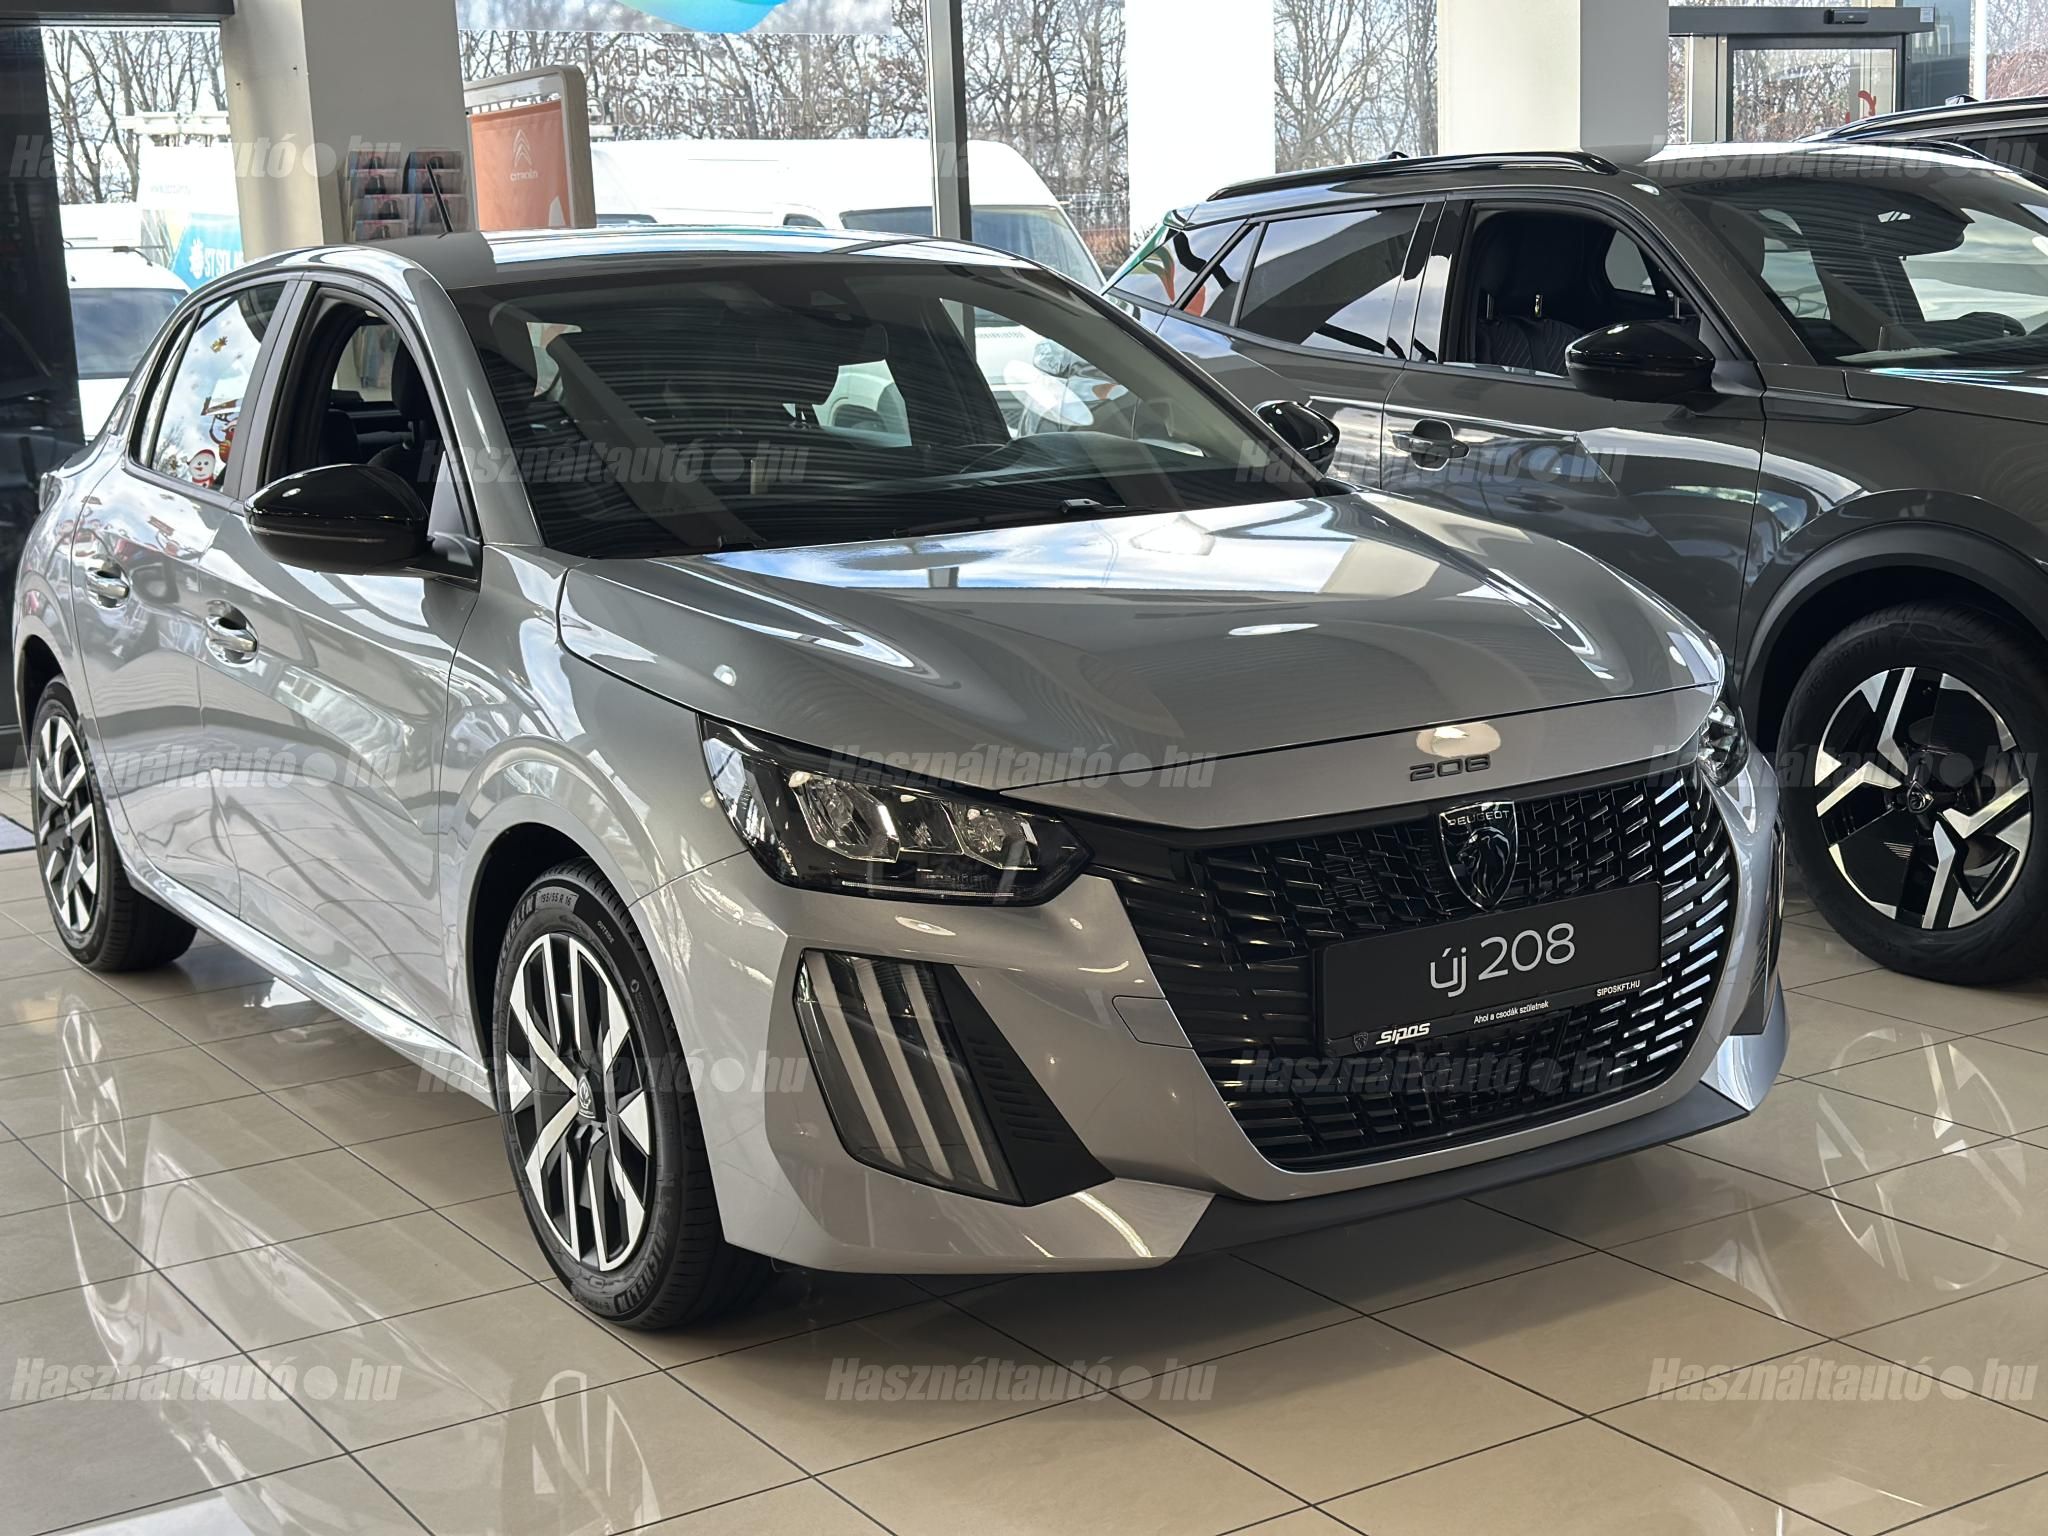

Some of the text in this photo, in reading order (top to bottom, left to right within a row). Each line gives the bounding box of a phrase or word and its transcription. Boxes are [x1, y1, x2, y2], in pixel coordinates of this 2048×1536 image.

[1409, 753, 1491, 782] 208
[1448, 809, 1510, 826] PEUGEOT
[1429, 922, 1576, 998] új 208
[1596, 980, 1641, 998] SIPOSKFT.HU
[1473, 1012, 1489, 1025] Ahol
[1495, 1007, 1519, 1019] csodák
